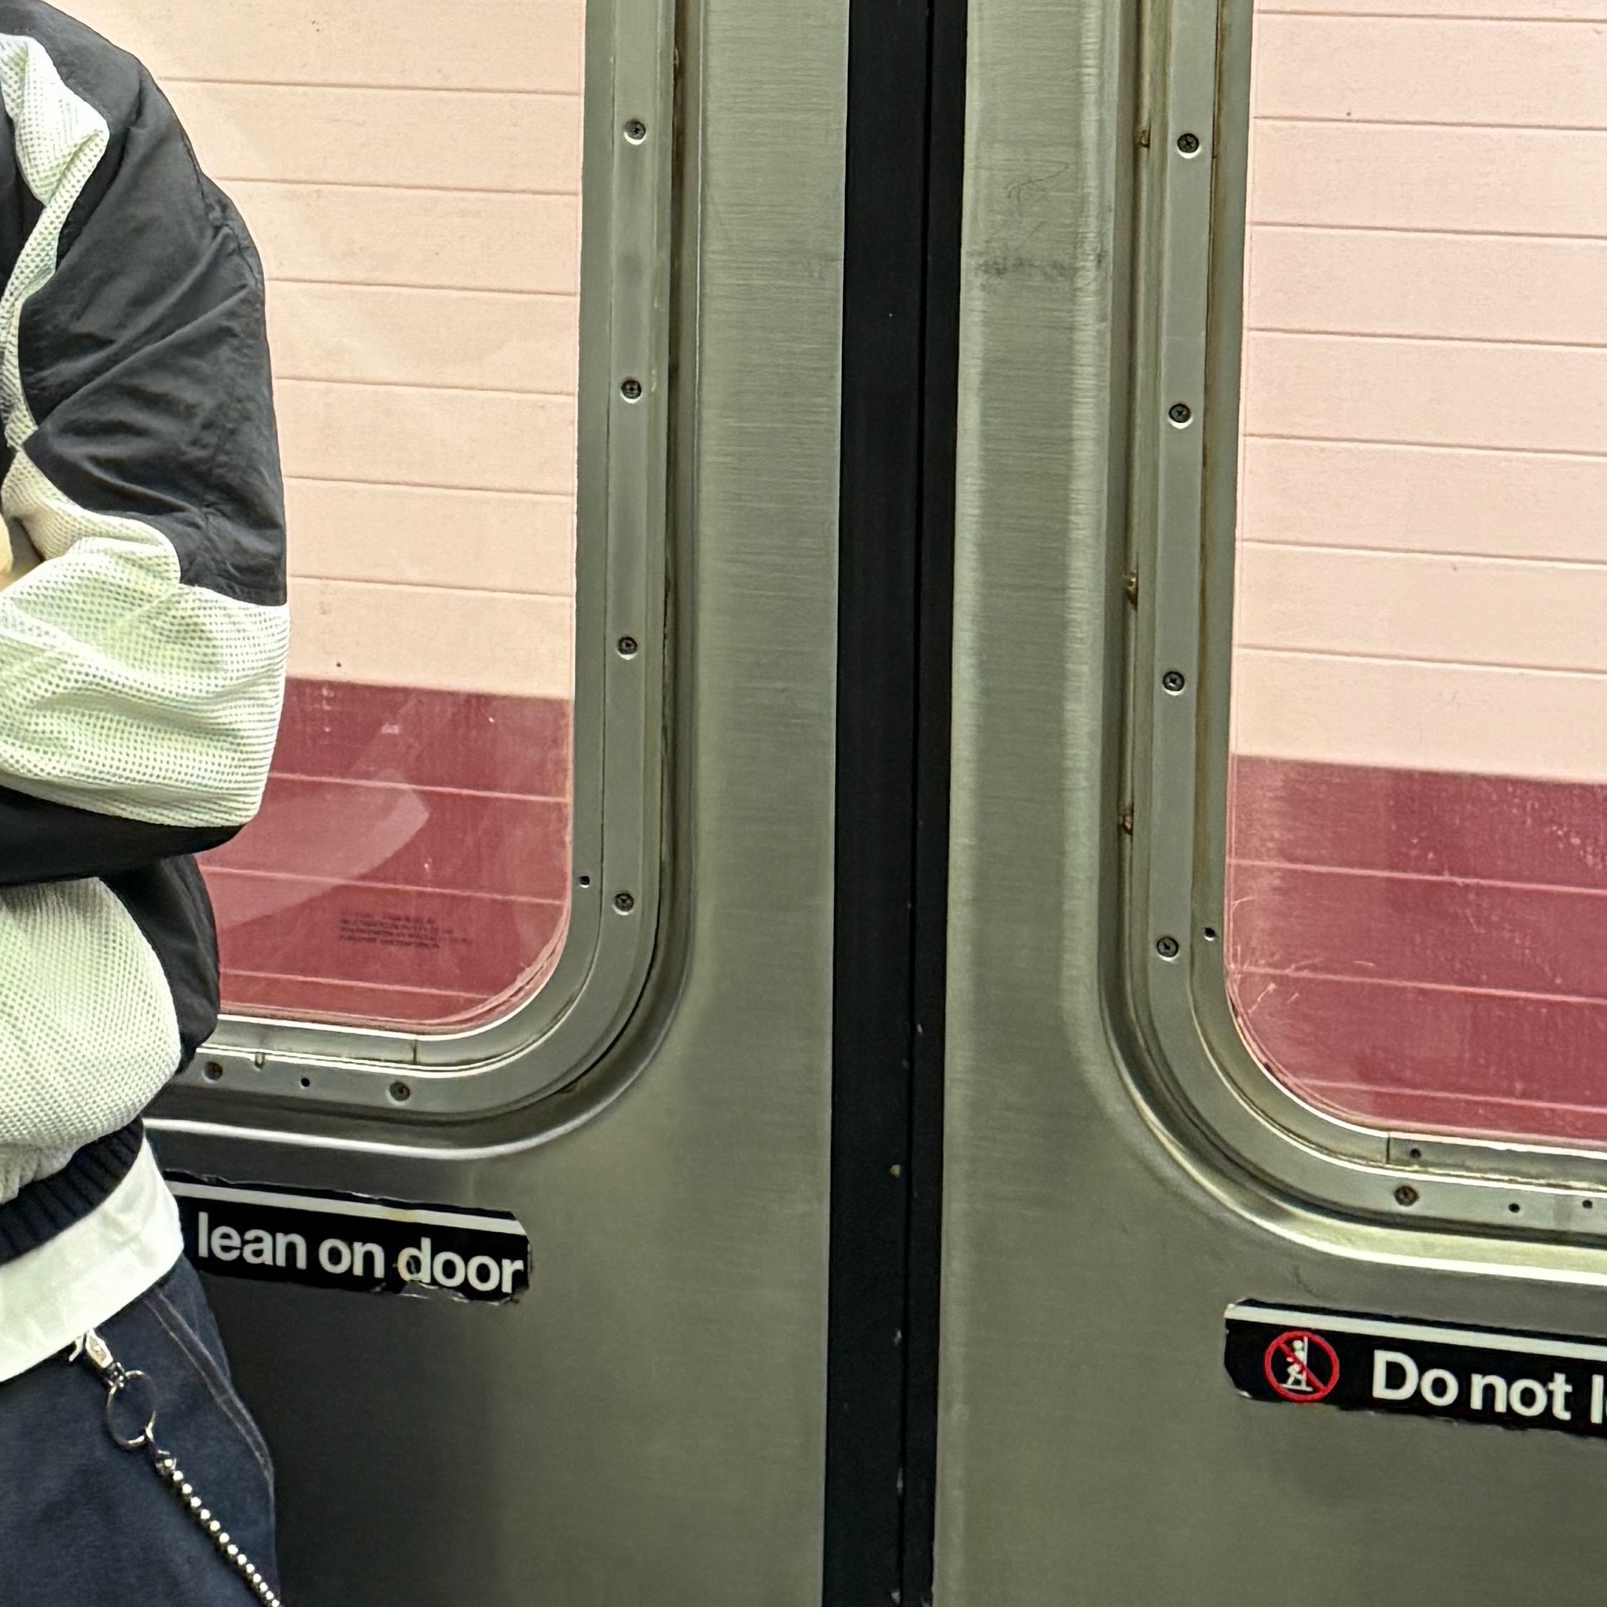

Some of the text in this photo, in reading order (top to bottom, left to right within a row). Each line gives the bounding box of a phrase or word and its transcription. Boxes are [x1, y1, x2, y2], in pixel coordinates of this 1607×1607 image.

[198, 1211, 524, 1294] lean on door
[1373, 1349, 1459, 1407] Do
[1470, 1372, 1573, 1421] not
